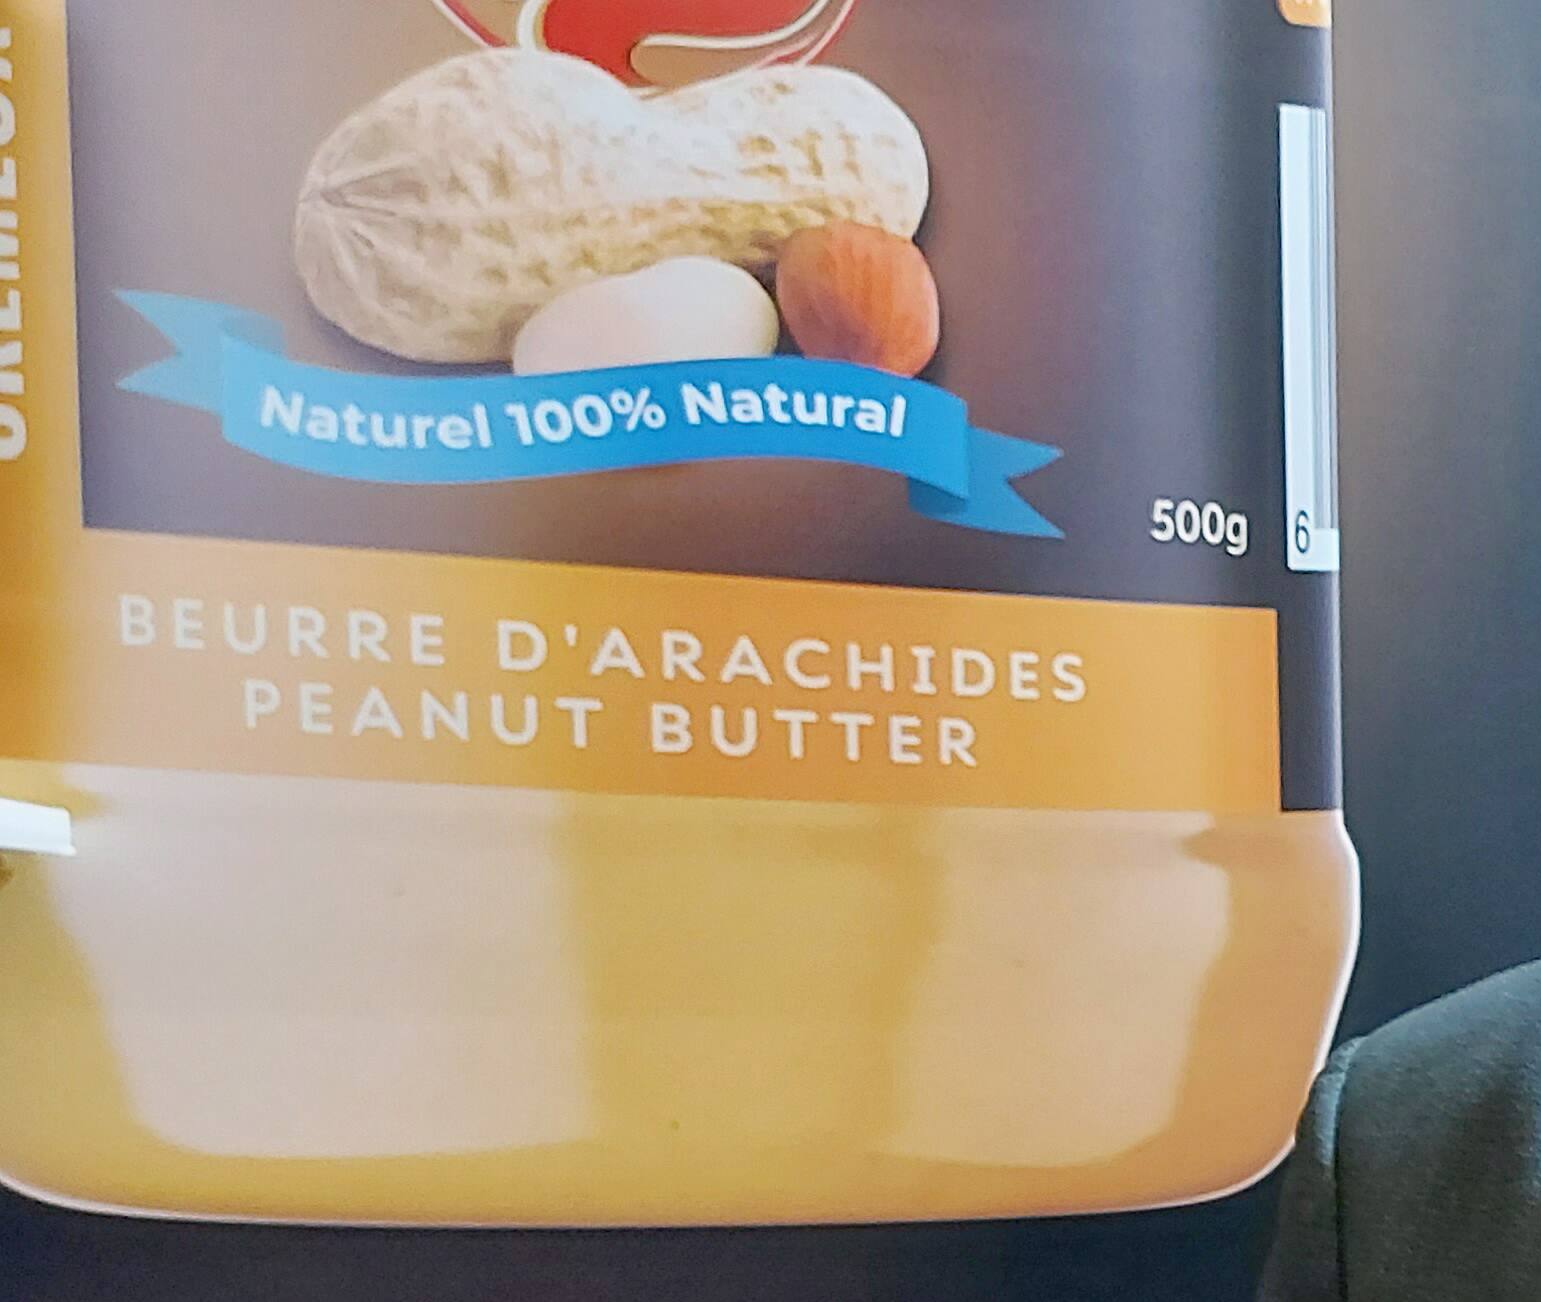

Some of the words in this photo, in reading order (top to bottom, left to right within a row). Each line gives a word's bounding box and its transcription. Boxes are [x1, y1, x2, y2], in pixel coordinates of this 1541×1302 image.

[259, 384, 492, 450] Naturel
[505, 386, 666, 447] 100%
[680, 381, 907, 438] Natural
[1149, 498, 1249, 557] 500g
[117, 593, 446, 668] BEURRE
[496, 619, 1087, 704] D'ARACHIDES
[243, 677, 603, 748] PEANUT
[650, 702, 978, 768] BUTTER
